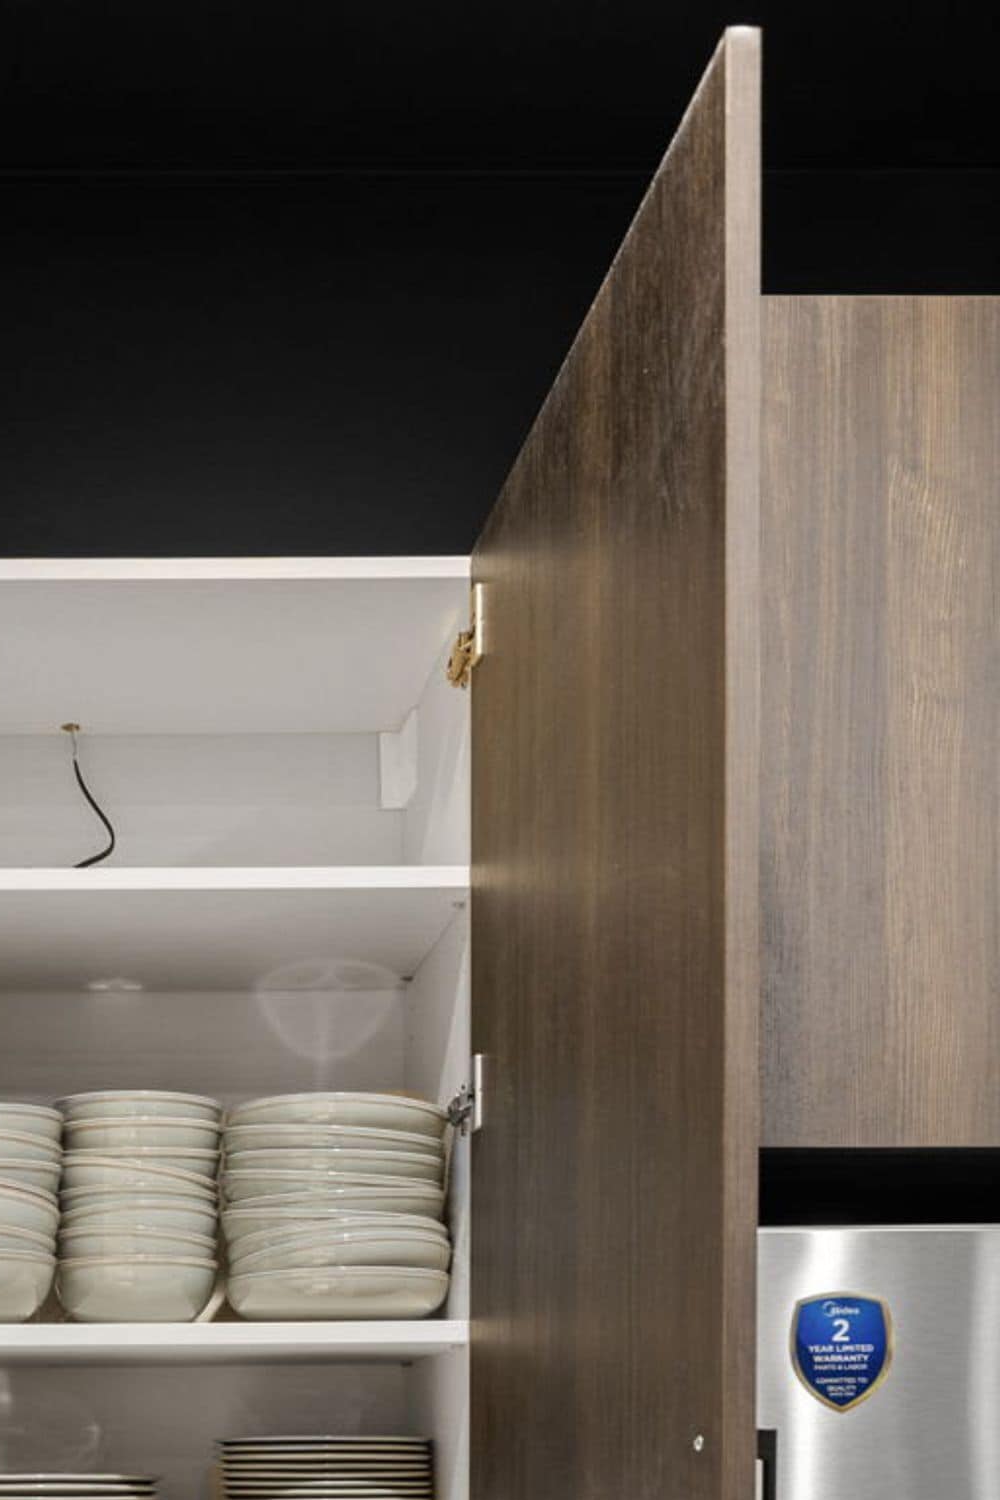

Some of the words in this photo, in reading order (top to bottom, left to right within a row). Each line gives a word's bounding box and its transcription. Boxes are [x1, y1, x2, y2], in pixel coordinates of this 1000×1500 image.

[827, 1304, 860, 1316] Midea
[831, 1319, 850, 1342] 2
[808, 1344, 834, 1353] YEAR
[836, 1344, 874, 1353] LIMITED
[813, 1354, 869, 1362] WARRANTY
